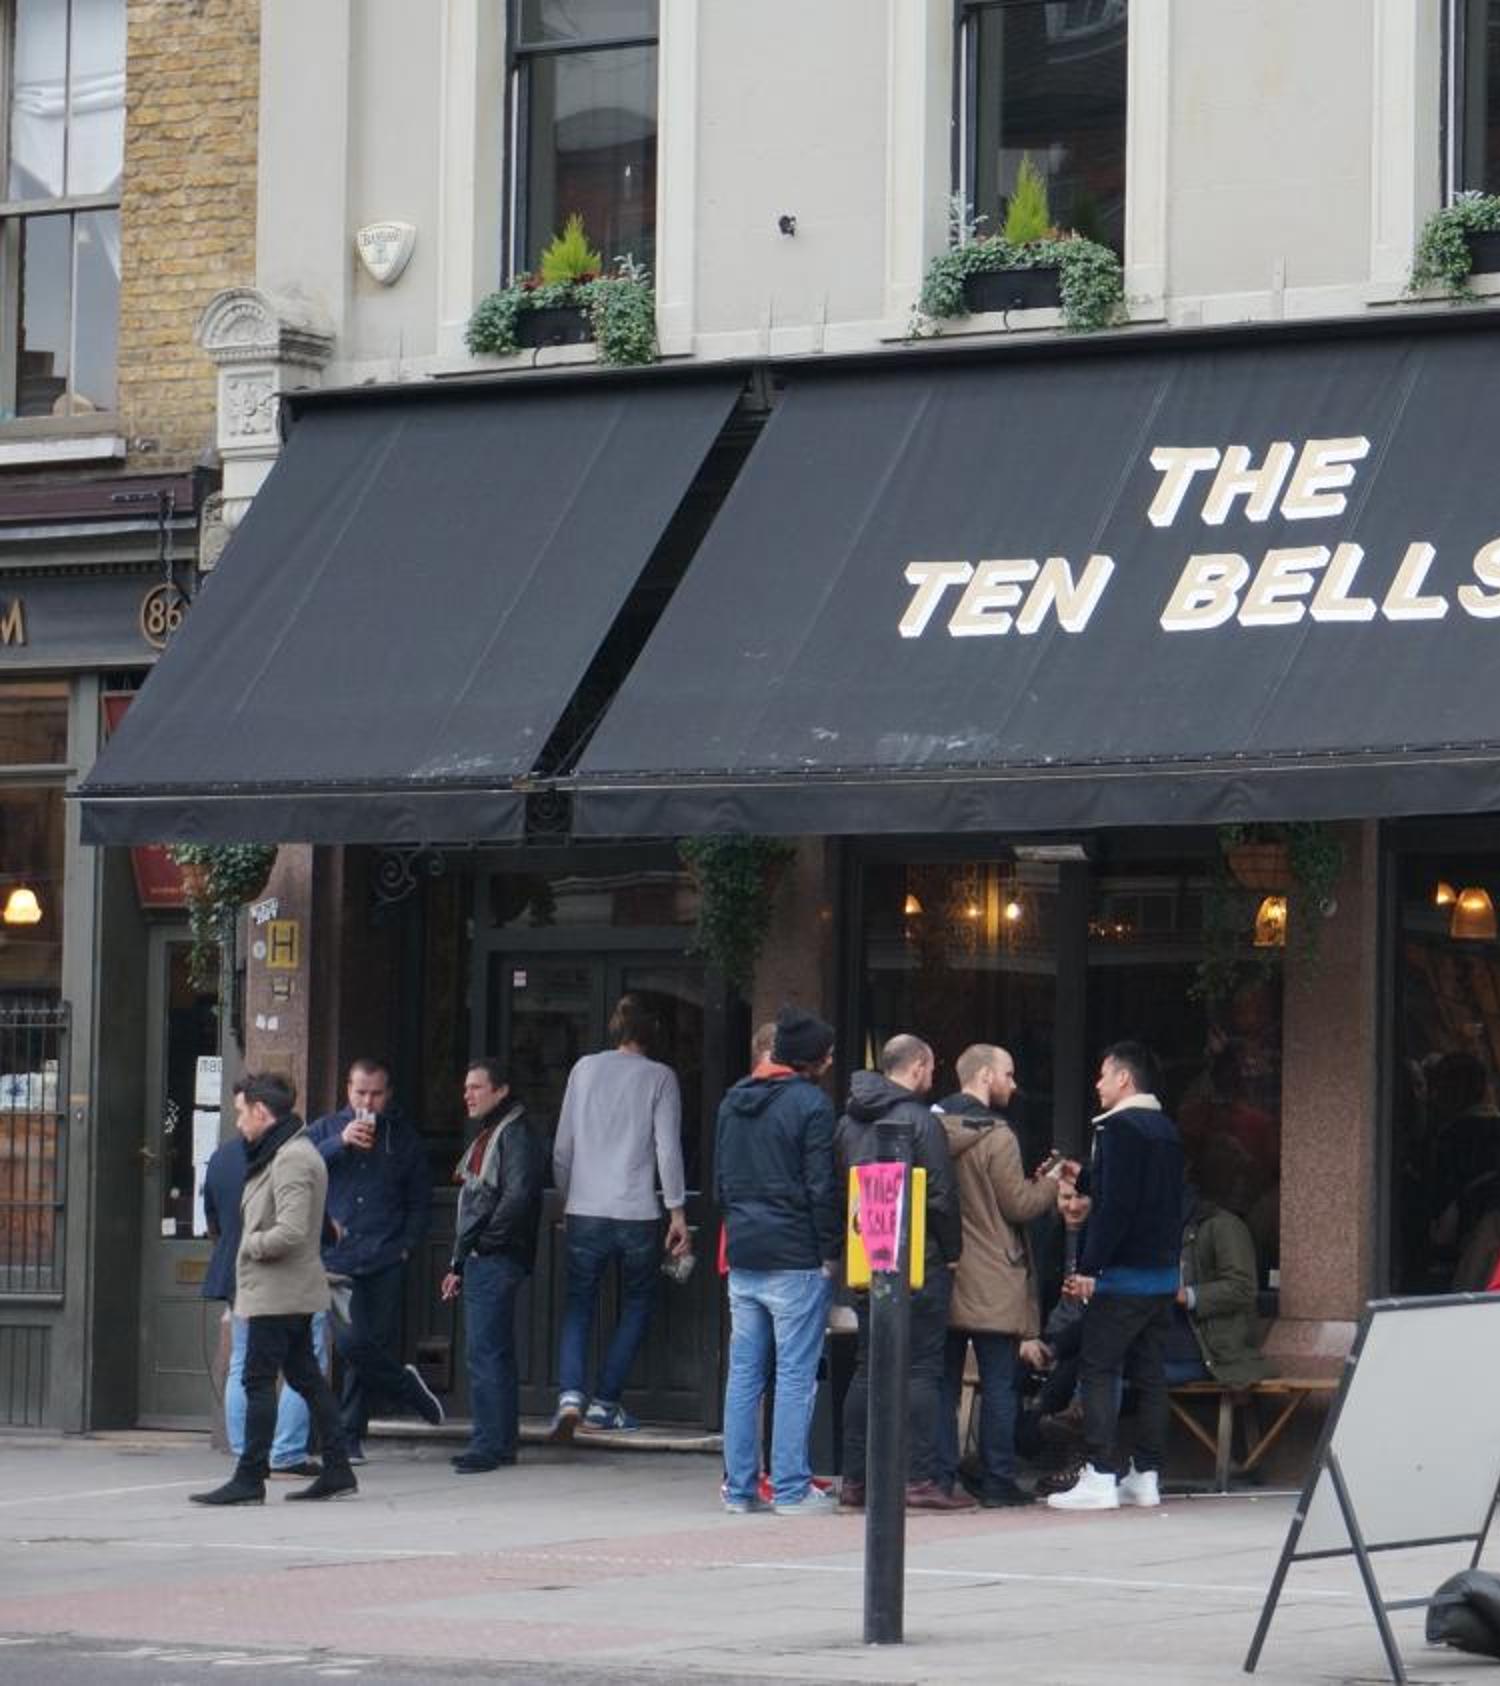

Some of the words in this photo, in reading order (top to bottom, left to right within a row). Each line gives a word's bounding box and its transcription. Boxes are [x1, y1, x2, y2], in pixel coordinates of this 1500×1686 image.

[1147, 435, 1370, 527] THE
[149, 599, 182, 634] 86
[899, 554, 1115, 637] TEN
[271, 924, 296, 963] H
